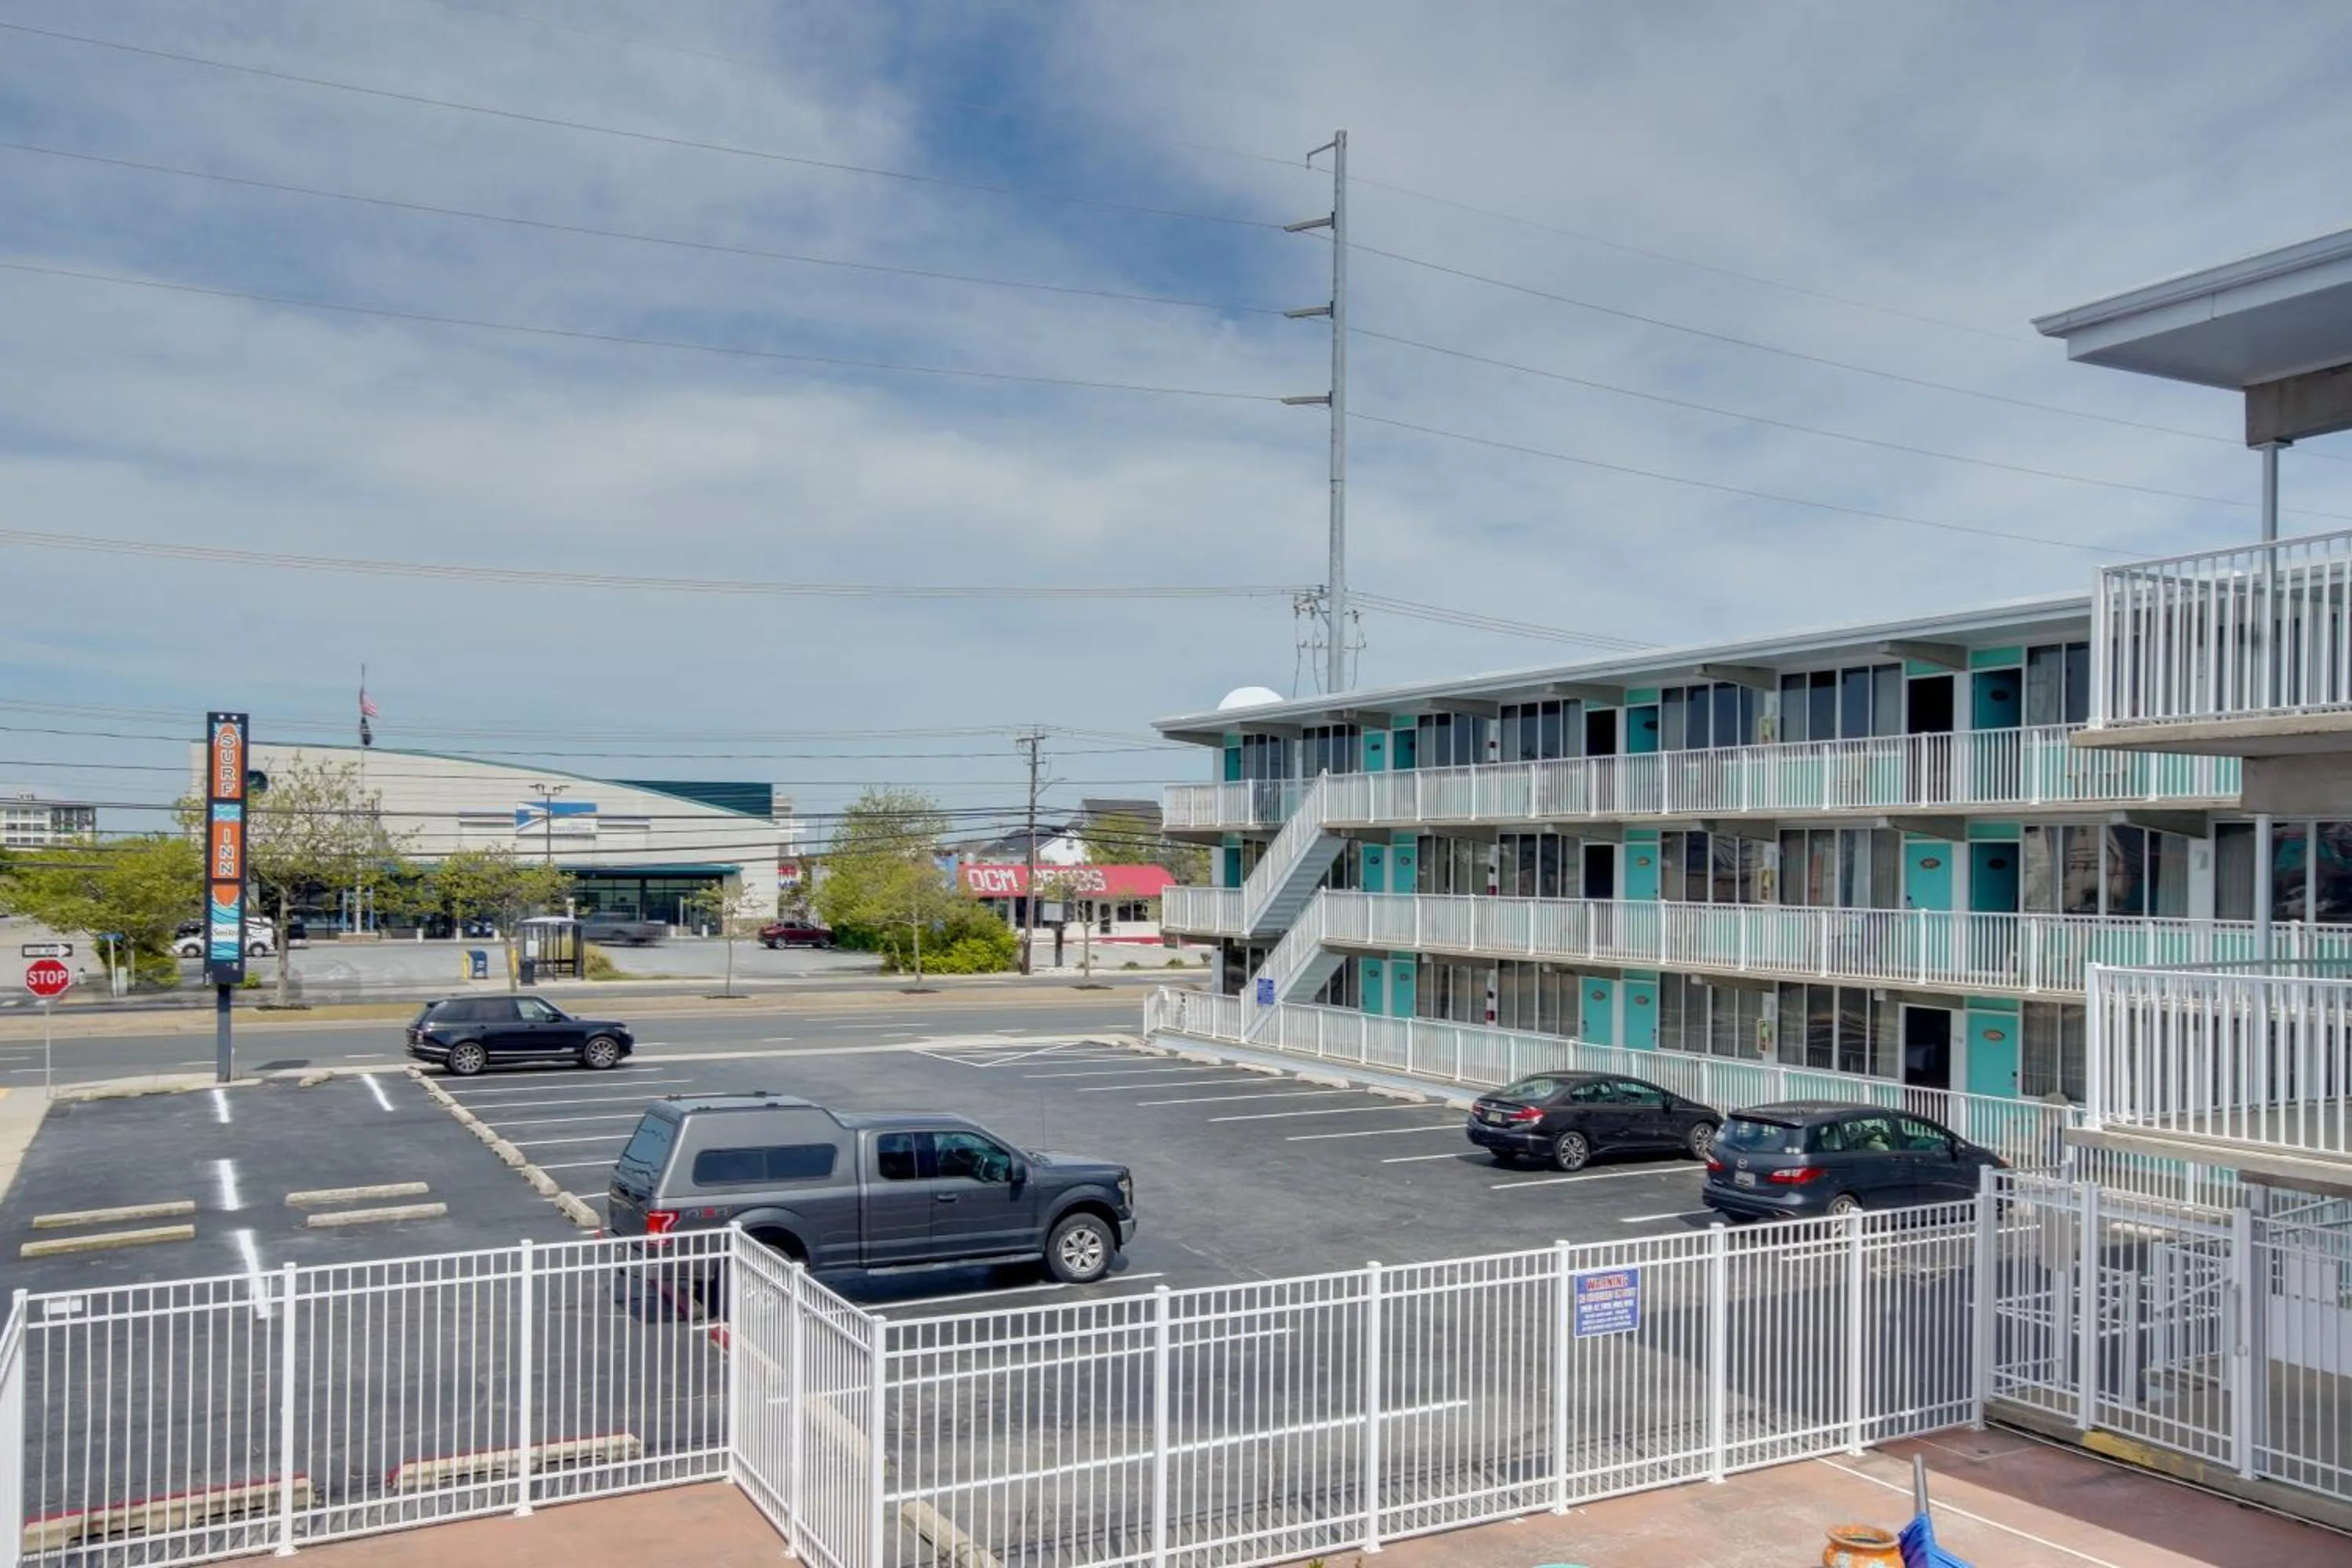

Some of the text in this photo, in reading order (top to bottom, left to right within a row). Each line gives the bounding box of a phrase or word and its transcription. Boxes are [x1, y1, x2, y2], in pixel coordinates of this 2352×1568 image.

[219, 735, 236, 877] SURF INN
[967, 869, 1019, 892] OCM
[27, 970, 67, 985] STOP
